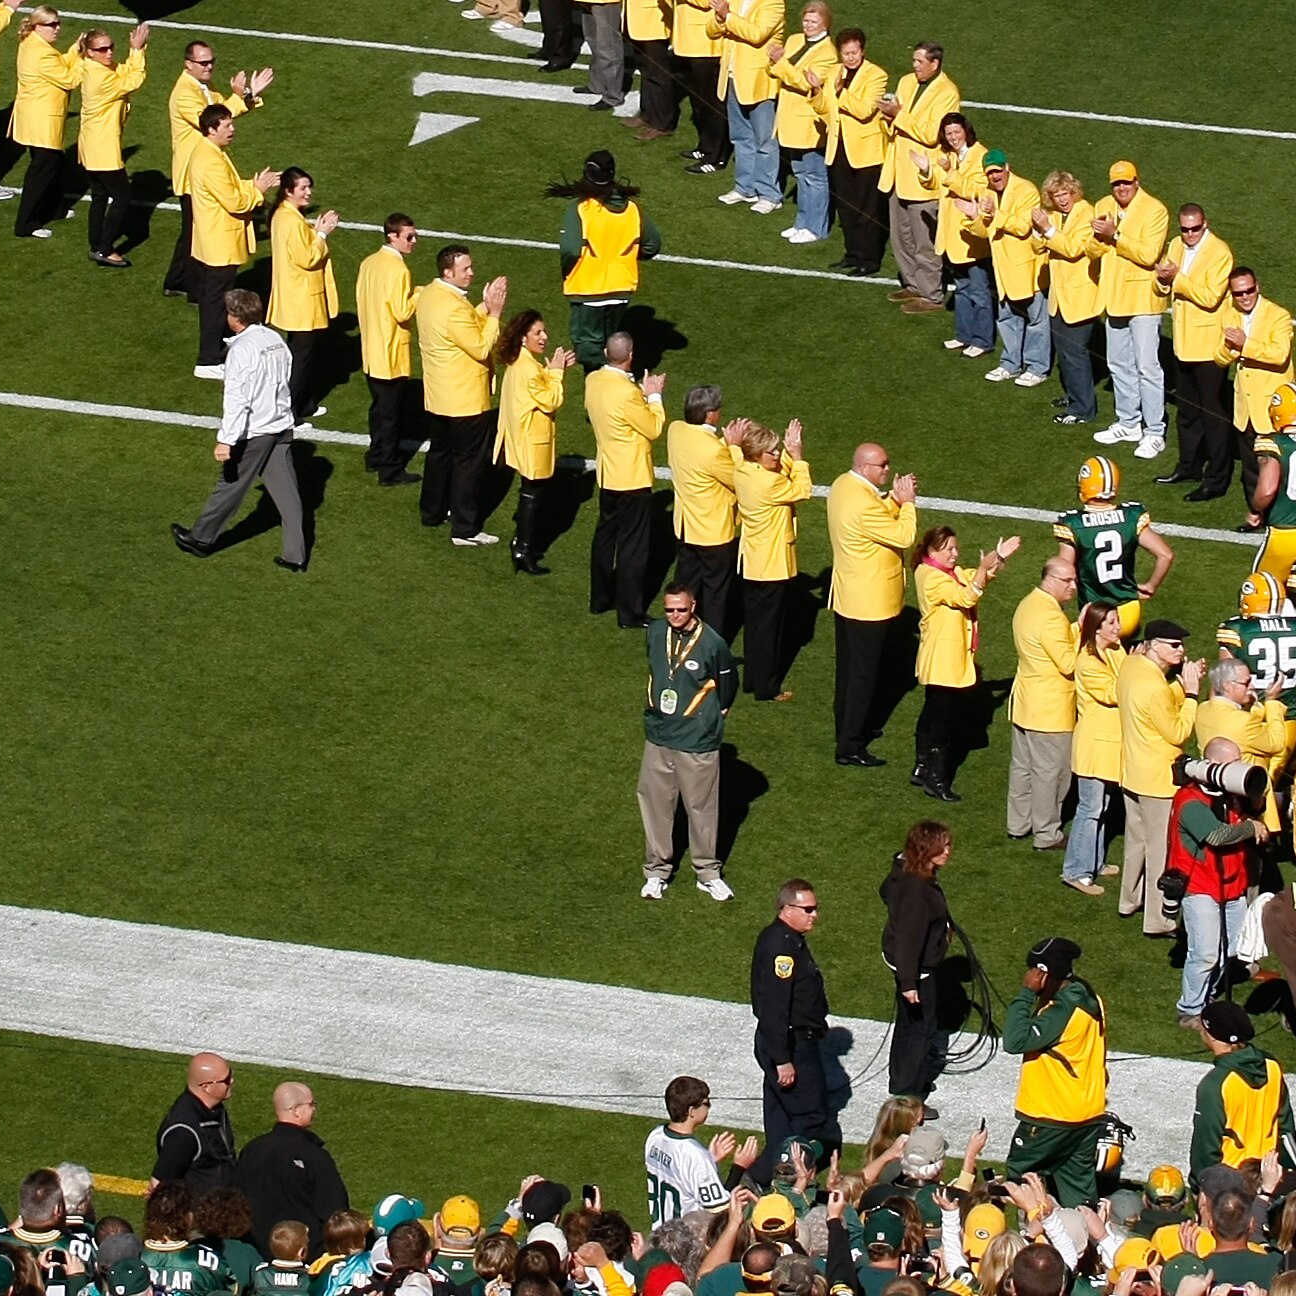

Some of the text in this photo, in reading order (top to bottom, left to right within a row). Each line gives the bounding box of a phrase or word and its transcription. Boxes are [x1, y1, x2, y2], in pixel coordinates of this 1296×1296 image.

[1083, 510, 1125, 532] CROSBY
[1095, 529, 1124, 585] 2
[1259, 618, 1292, 632] HALL
[699, 1183, 722, 1203] 80
